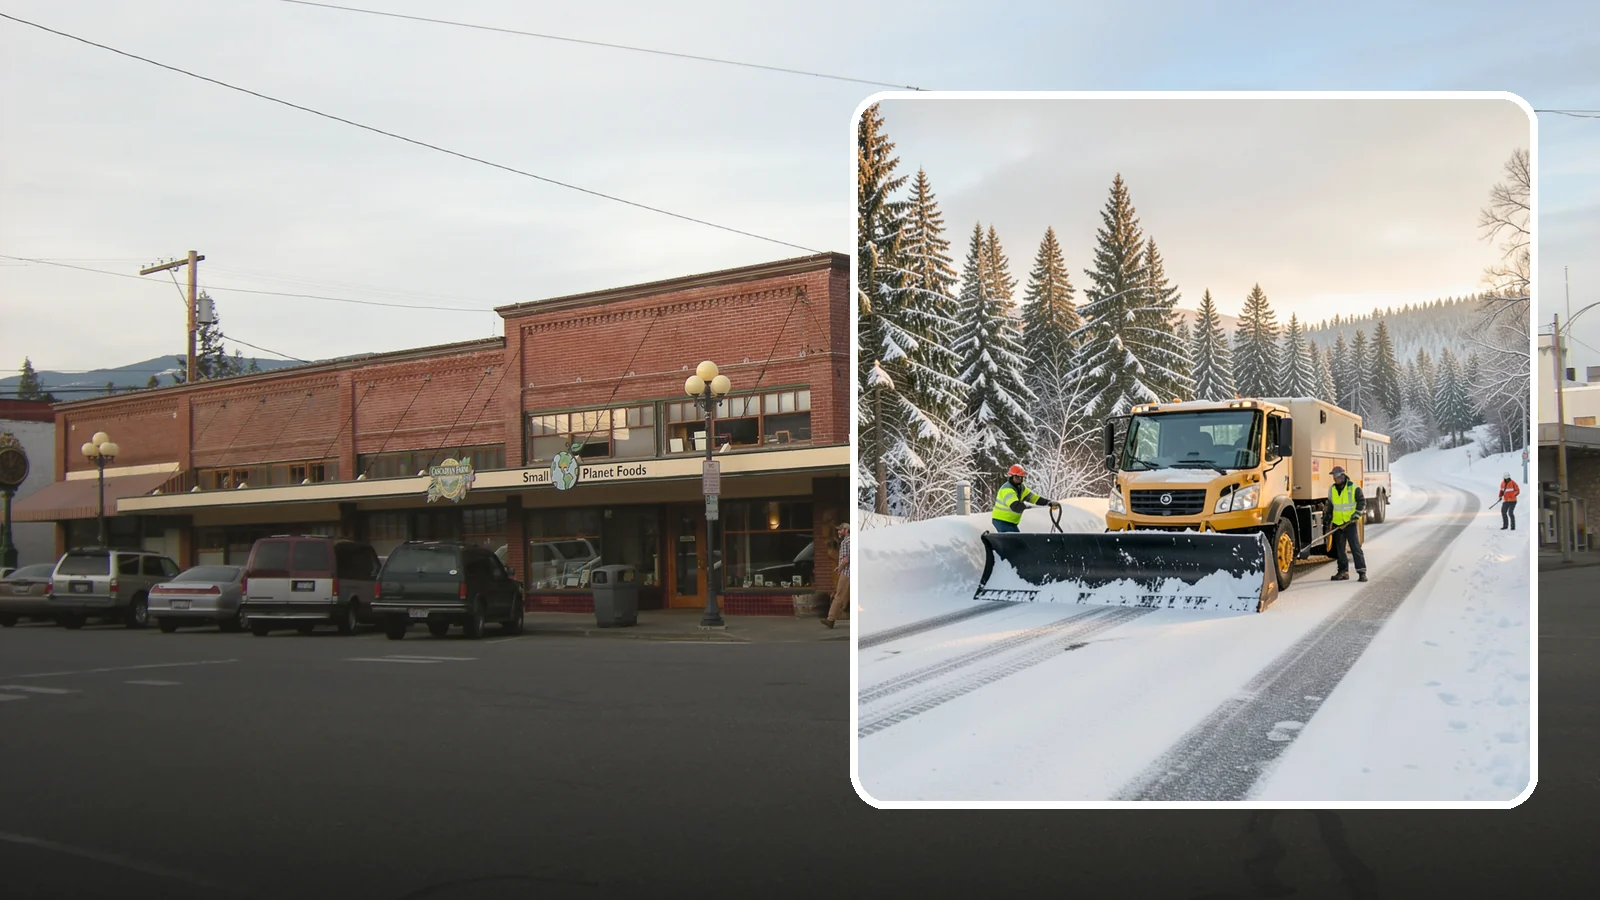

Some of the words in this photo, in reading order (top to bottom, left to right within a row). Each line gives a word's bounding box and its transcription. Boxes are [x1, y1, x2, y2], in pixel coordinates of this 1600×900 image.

[523, 471, 549, 483] Small
[582, 467, 614, 479] Planet
[616, 464, 647, 477] Foods
